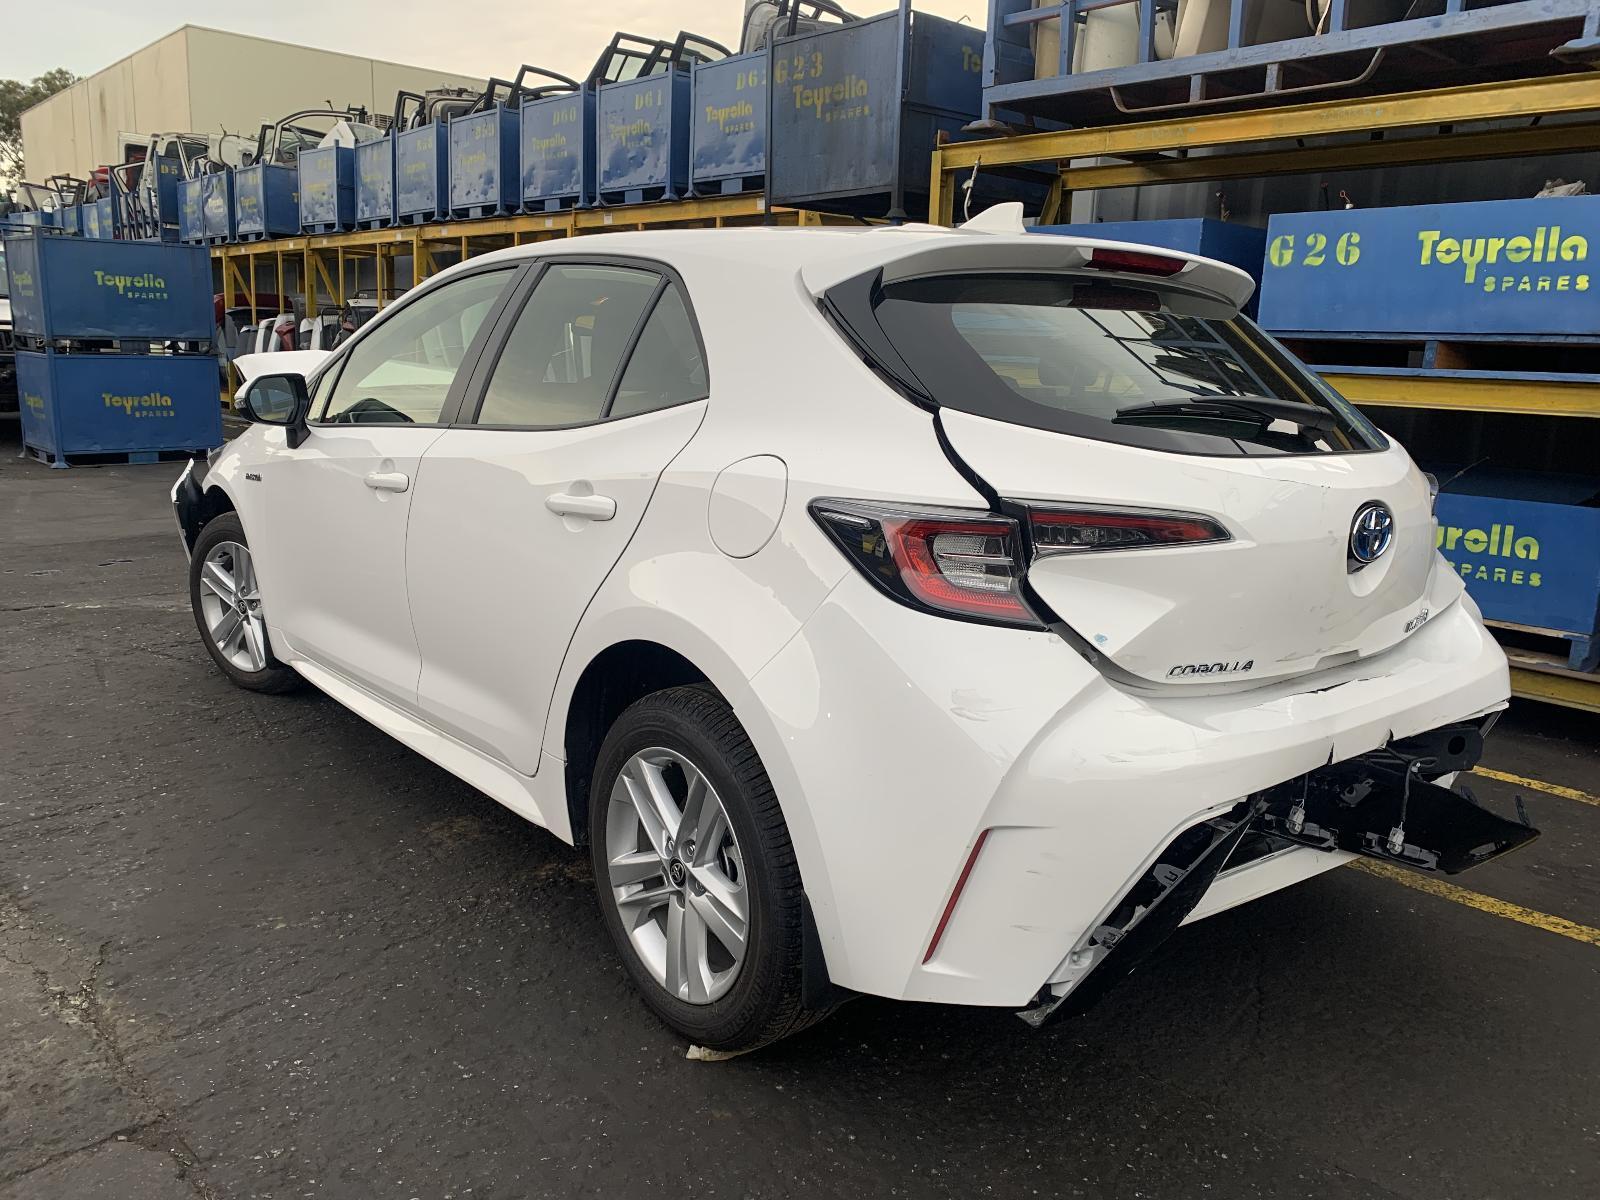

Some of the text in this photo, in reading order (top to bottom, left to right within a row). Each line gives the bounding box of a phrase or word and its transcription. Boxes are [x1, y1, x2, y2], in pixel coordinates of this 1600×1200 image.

[775, 52, 823, 84] G23
[793, 74, 868, 118] Toyrolla
[706, 100, 753, 131] Toyrolla
[1269, 231, 1361, 267] G26
[1418, 226, 1588, 283] Toyrolla
[94, 270, 166, 294] Toyrolla
[127, 291, 168, 299] SPARES
[1484, 274, 1590, 292] SPARES
[102, 392, 172, 415] Toyrolla
[1165, 659, 1254, 679] COROLLA
